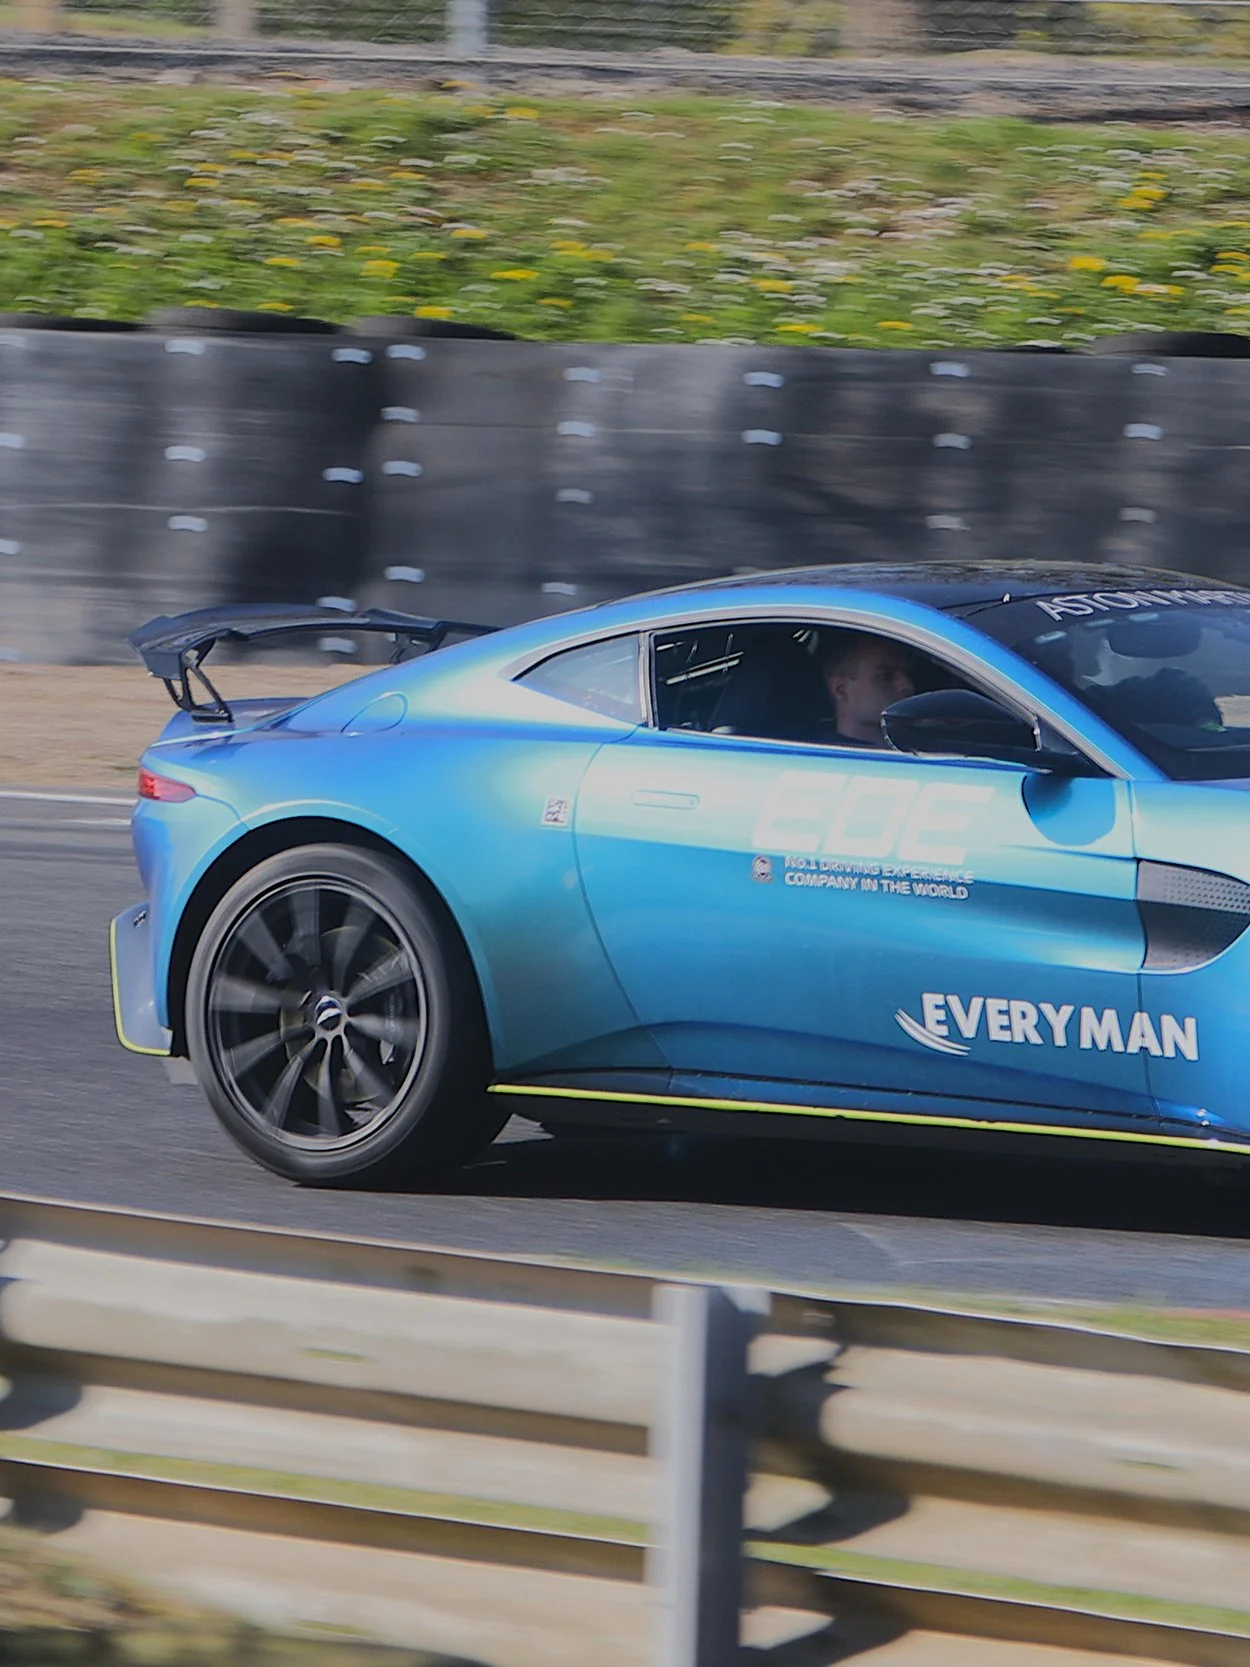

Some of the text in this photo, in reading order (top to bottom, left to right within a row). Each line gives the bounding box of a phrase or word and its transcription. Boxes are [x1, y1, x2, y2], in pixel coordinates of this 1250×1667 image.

[1035, 590, 1172, 621] ASTON
[784, 871, 969, 900] COMPANY IN THE WORLD
[820, 857, 881, 877] DRIVING
[882, 863, 975, 885] EXPERIENCE
[921, 992, 1199, 1062] EVERYMAN
